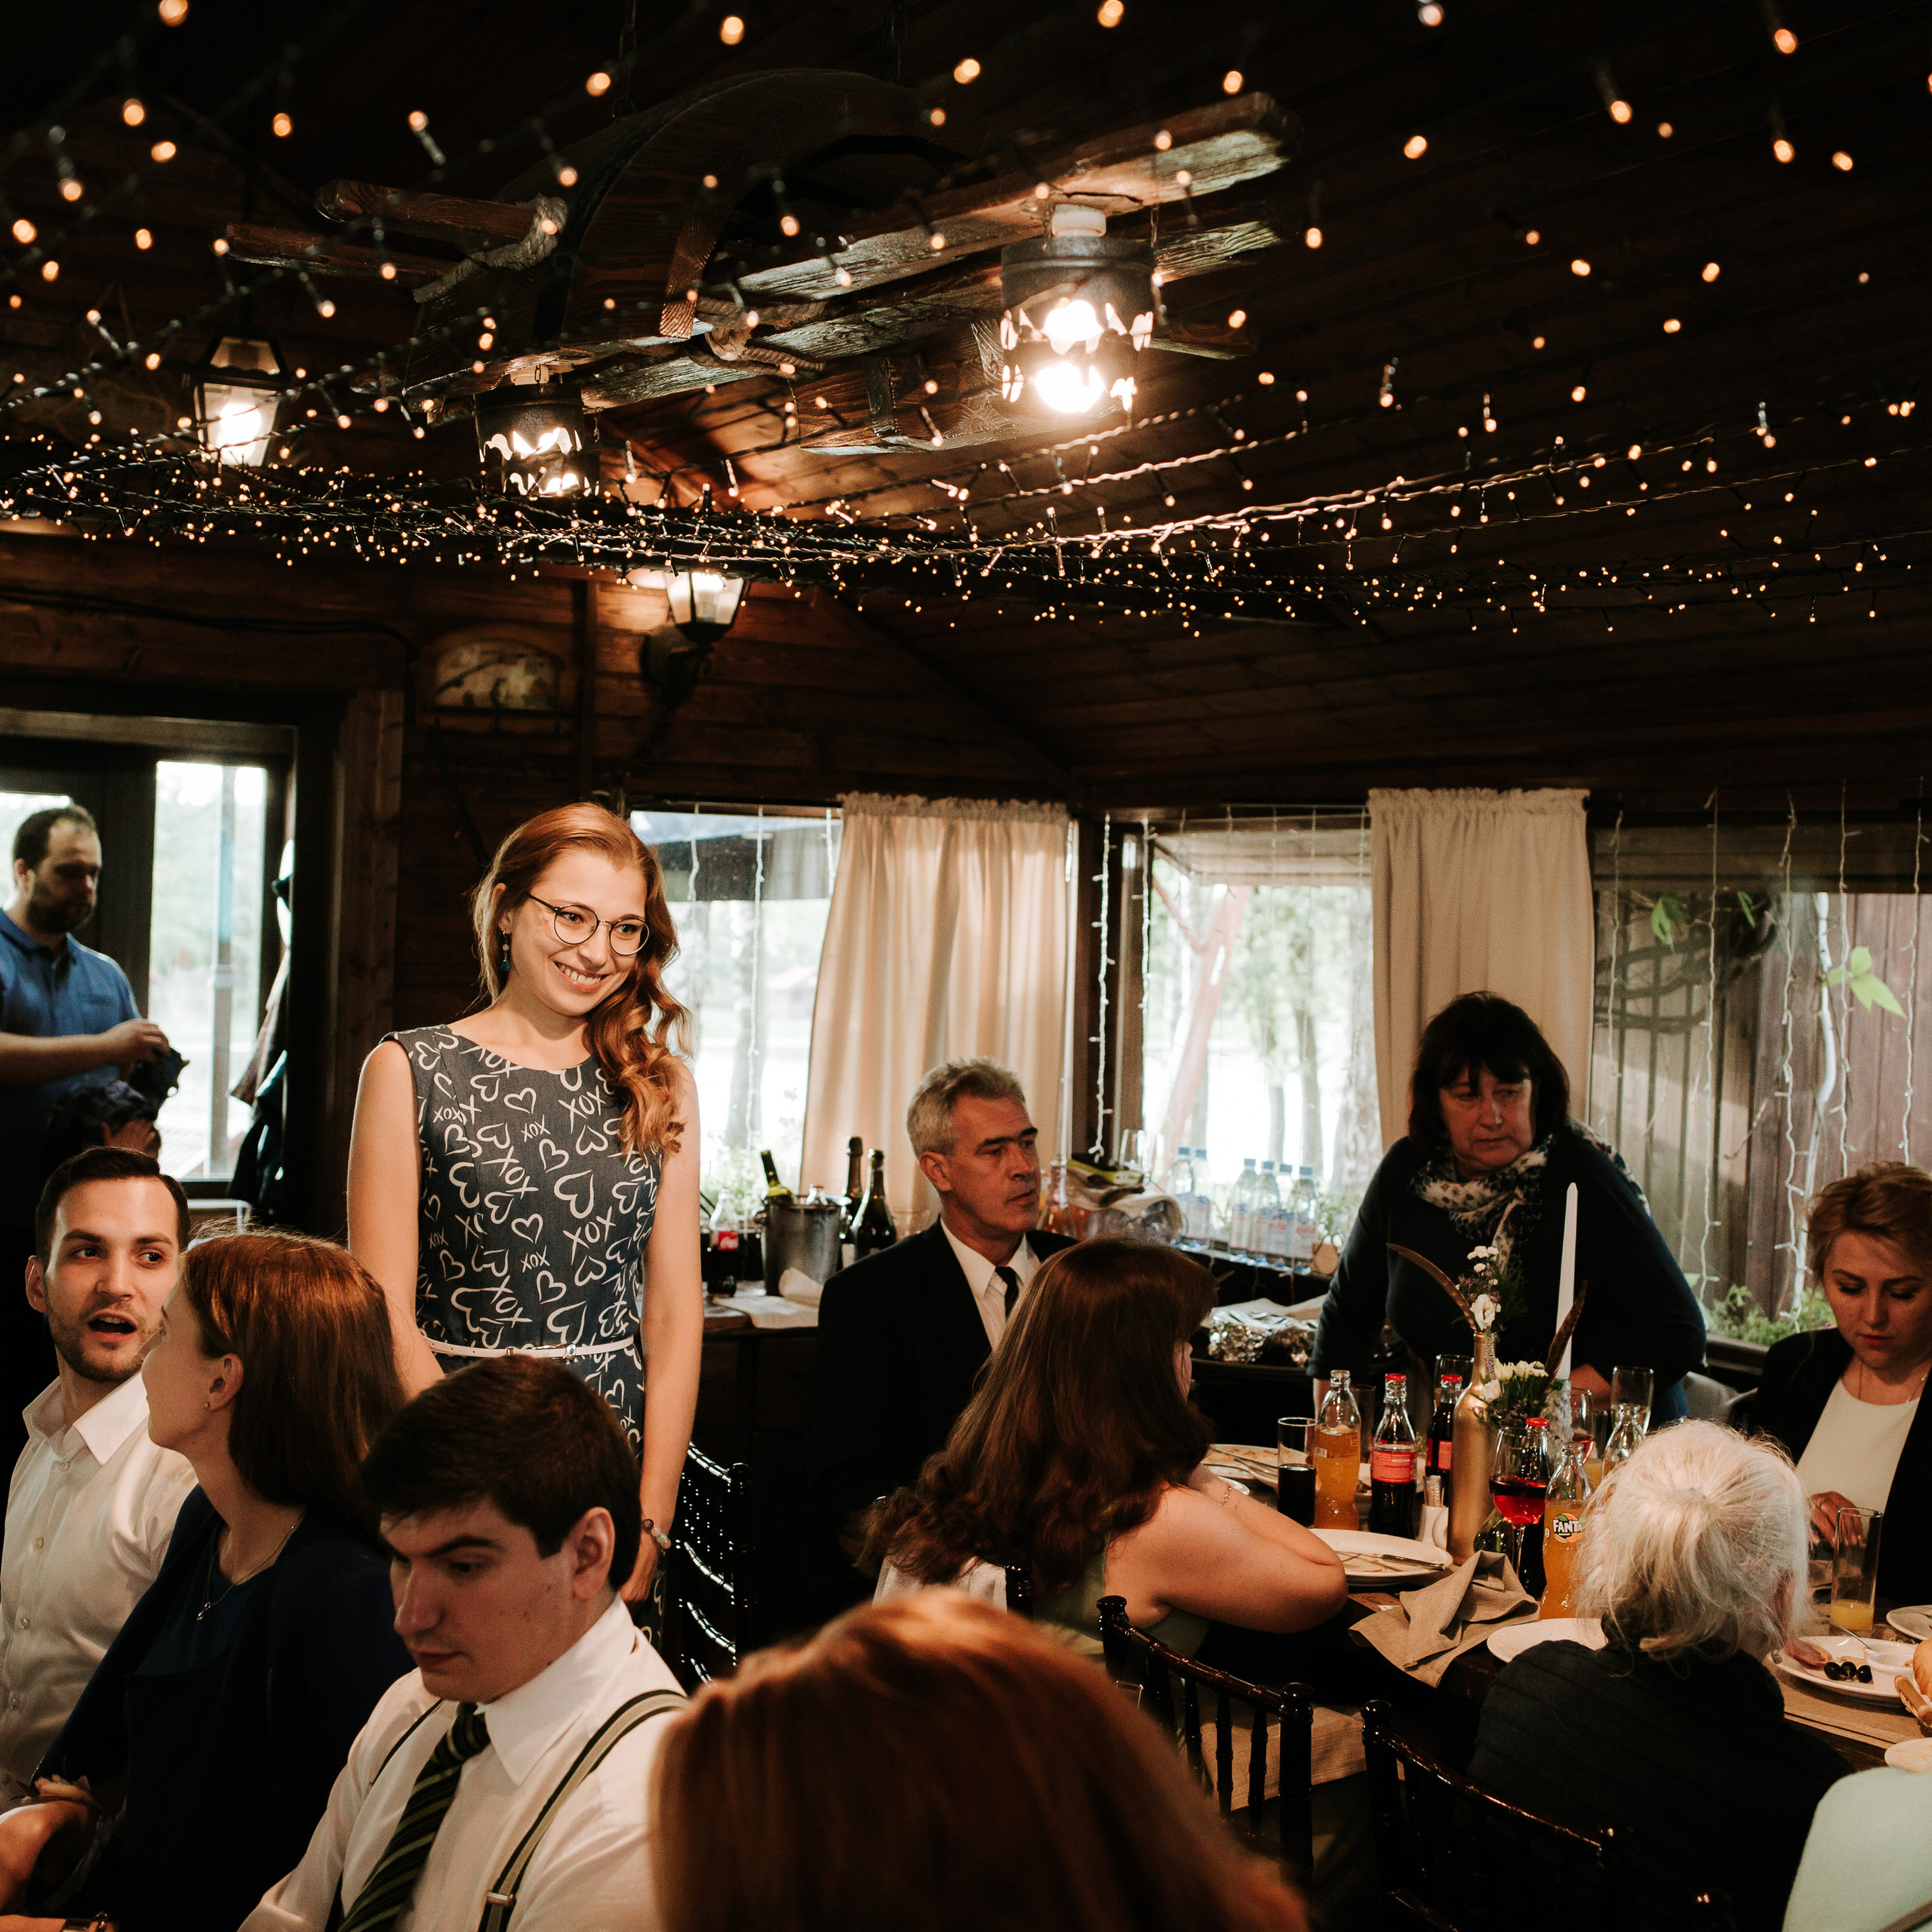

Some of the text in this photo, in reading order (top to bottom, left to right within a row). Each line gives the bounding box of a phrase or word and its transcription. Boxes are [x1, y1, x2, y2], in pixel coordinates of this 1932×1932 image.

[558, 1085, 606, 1134] XOX
[481, 1146, 539, 1200] XOX
[563, 1206, 616, 1266] XOX
[483, 1275, 532, 1328] XOX
